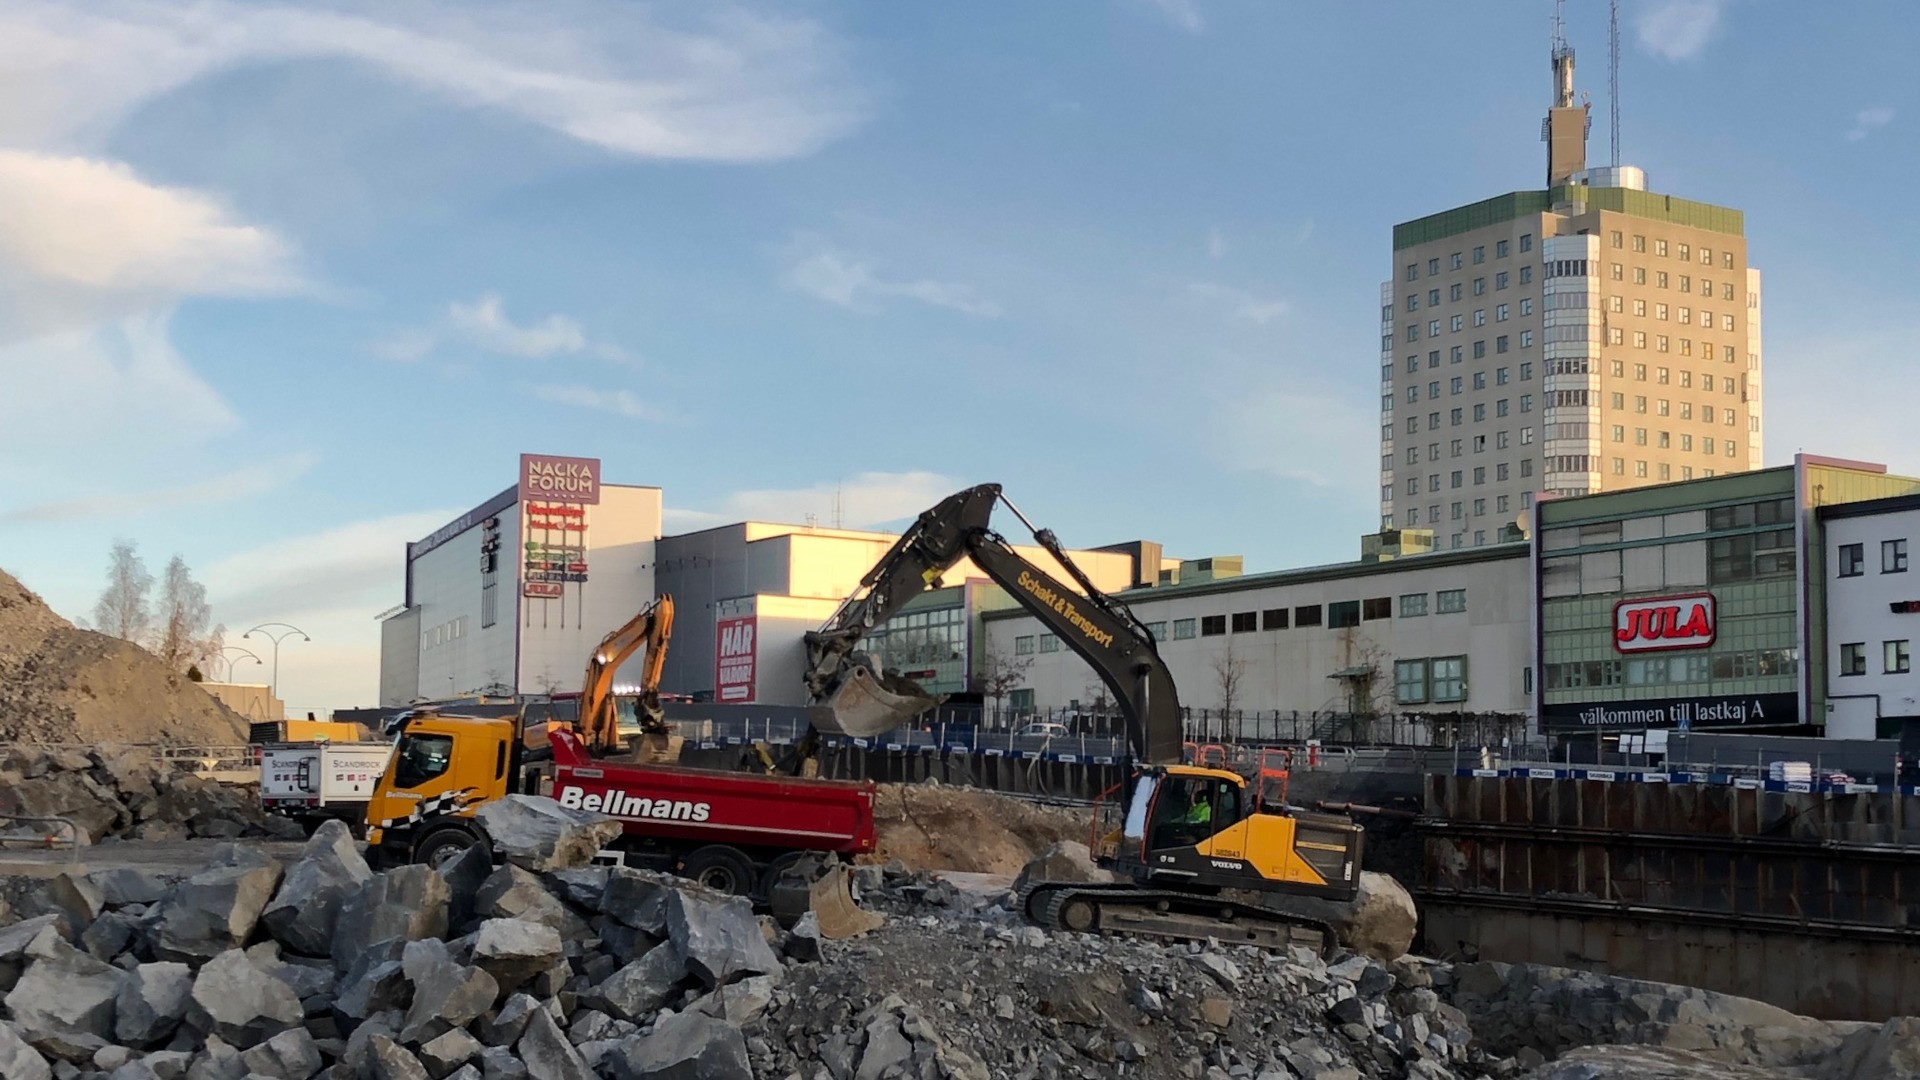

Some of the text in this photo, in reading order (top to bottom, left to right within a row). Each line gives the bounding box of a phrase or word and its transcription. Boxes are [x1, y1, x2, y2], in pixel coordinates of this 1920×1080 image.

[528, 461, 592, 478] NACKA
[528, 475, 592, 493] FORUM
[1018, 571, 1113, 648] Schakt & Transport
[1617, 604, 1711, 641] JULA
[721, 620, 753, 657] HÄR
[1579, 700, 1764, 725] välkommen till lastkaj A
[559, 785, 711, 822] Bellmans
[1211, 860, 1242, 870] VOLVO
